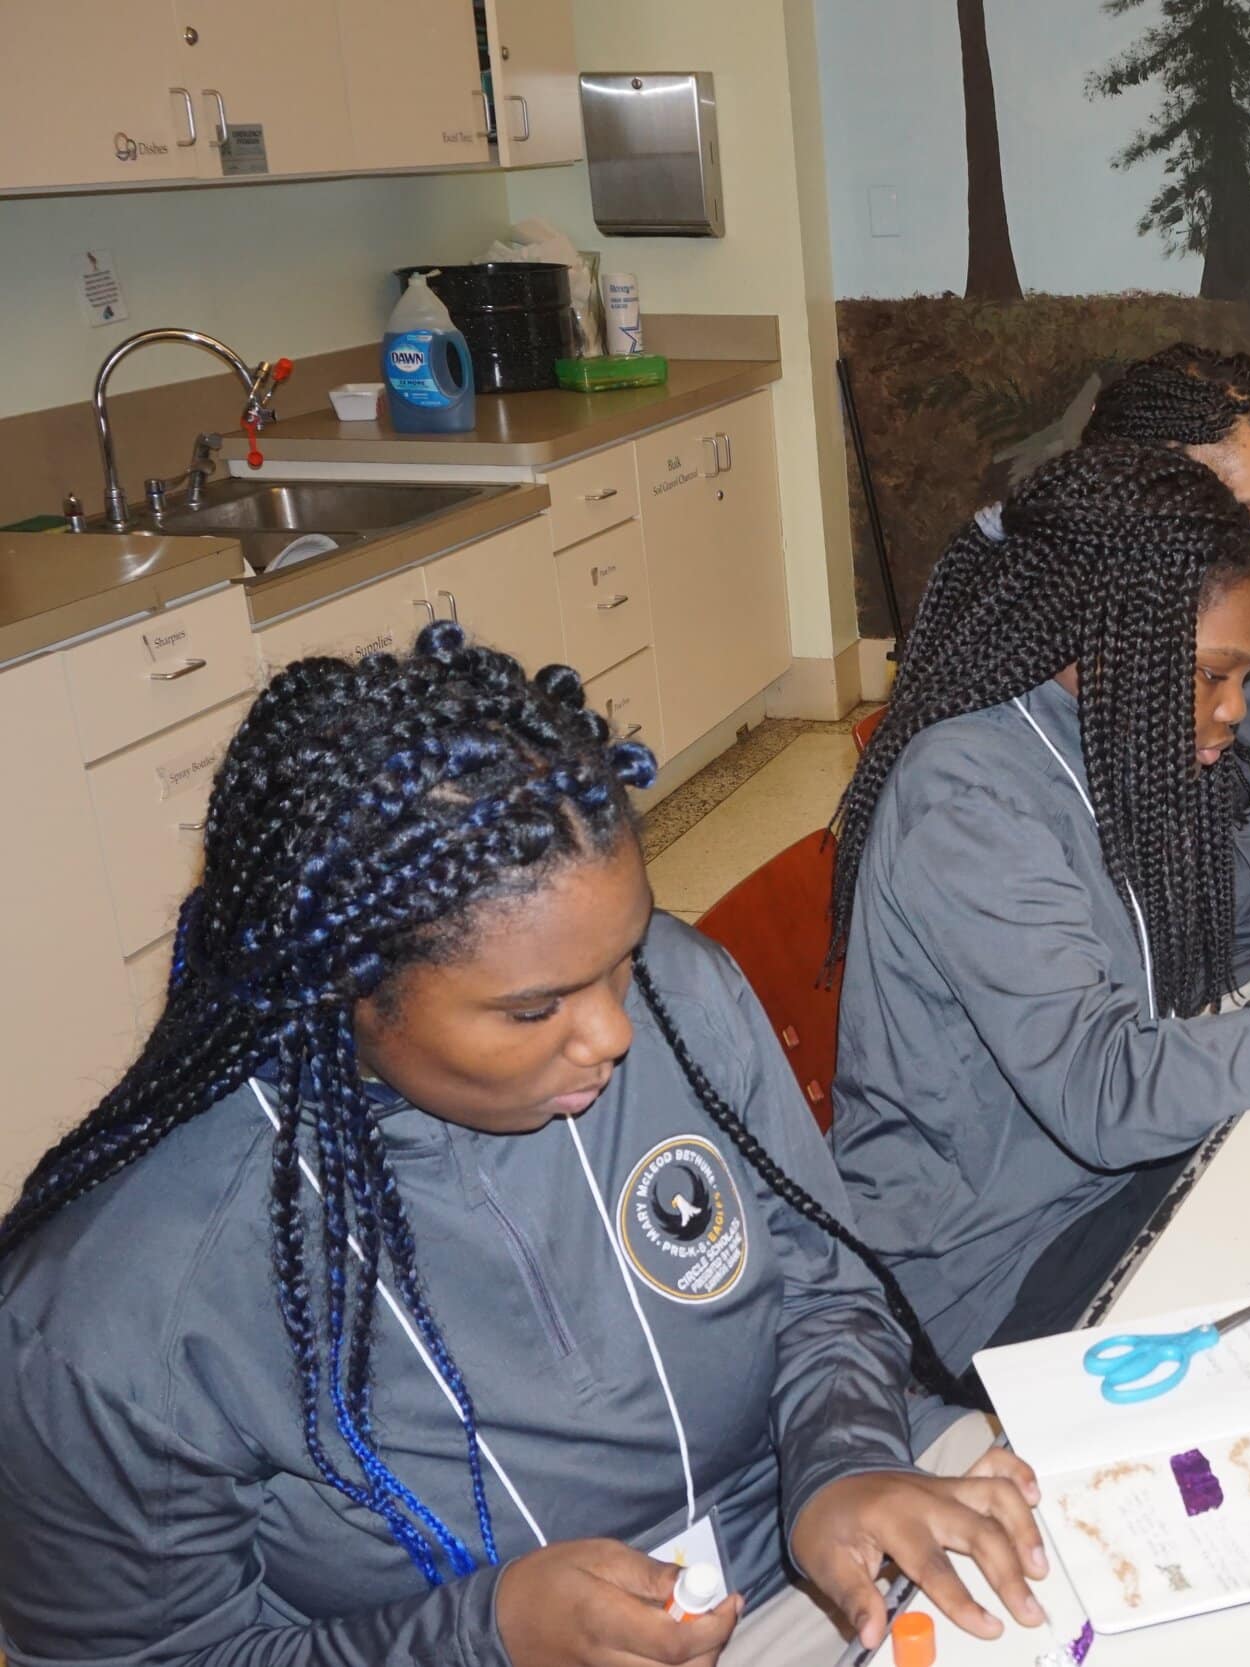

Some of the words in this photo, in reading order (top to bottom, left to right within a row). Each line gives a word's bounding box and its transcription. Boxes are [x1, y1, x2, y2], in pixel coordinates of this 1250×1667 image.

[139, 142, 168, 155] Dishes
[391, 351, 424, 365] DAWN
[355, 634, 392, 657] Supplies
[636, 1203, 660, 1242] MARY
[677, 1255, 709, 1290] CIRCLE
